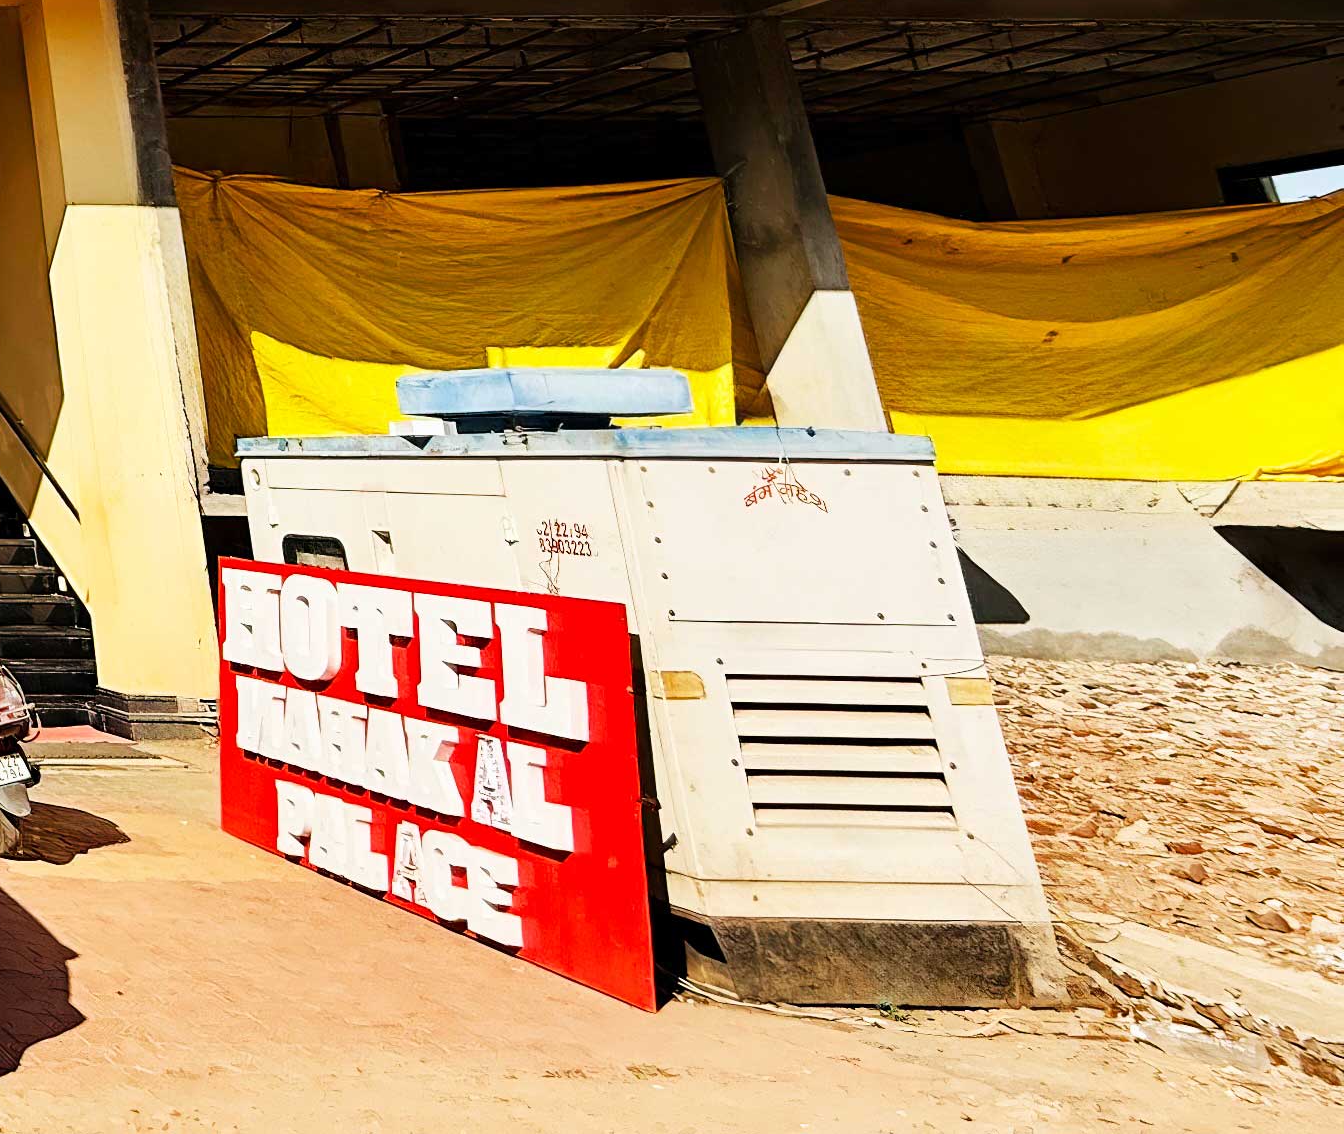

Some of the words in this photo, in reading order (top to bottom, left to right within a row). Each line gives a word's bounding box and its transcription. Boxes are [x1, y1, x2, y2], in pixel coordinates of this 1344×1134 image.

[222, 567, 591, 743] HOTEL
[236, 676, 575, 853] MAHAKAL
[275, 779, 524, 948] PALACE
